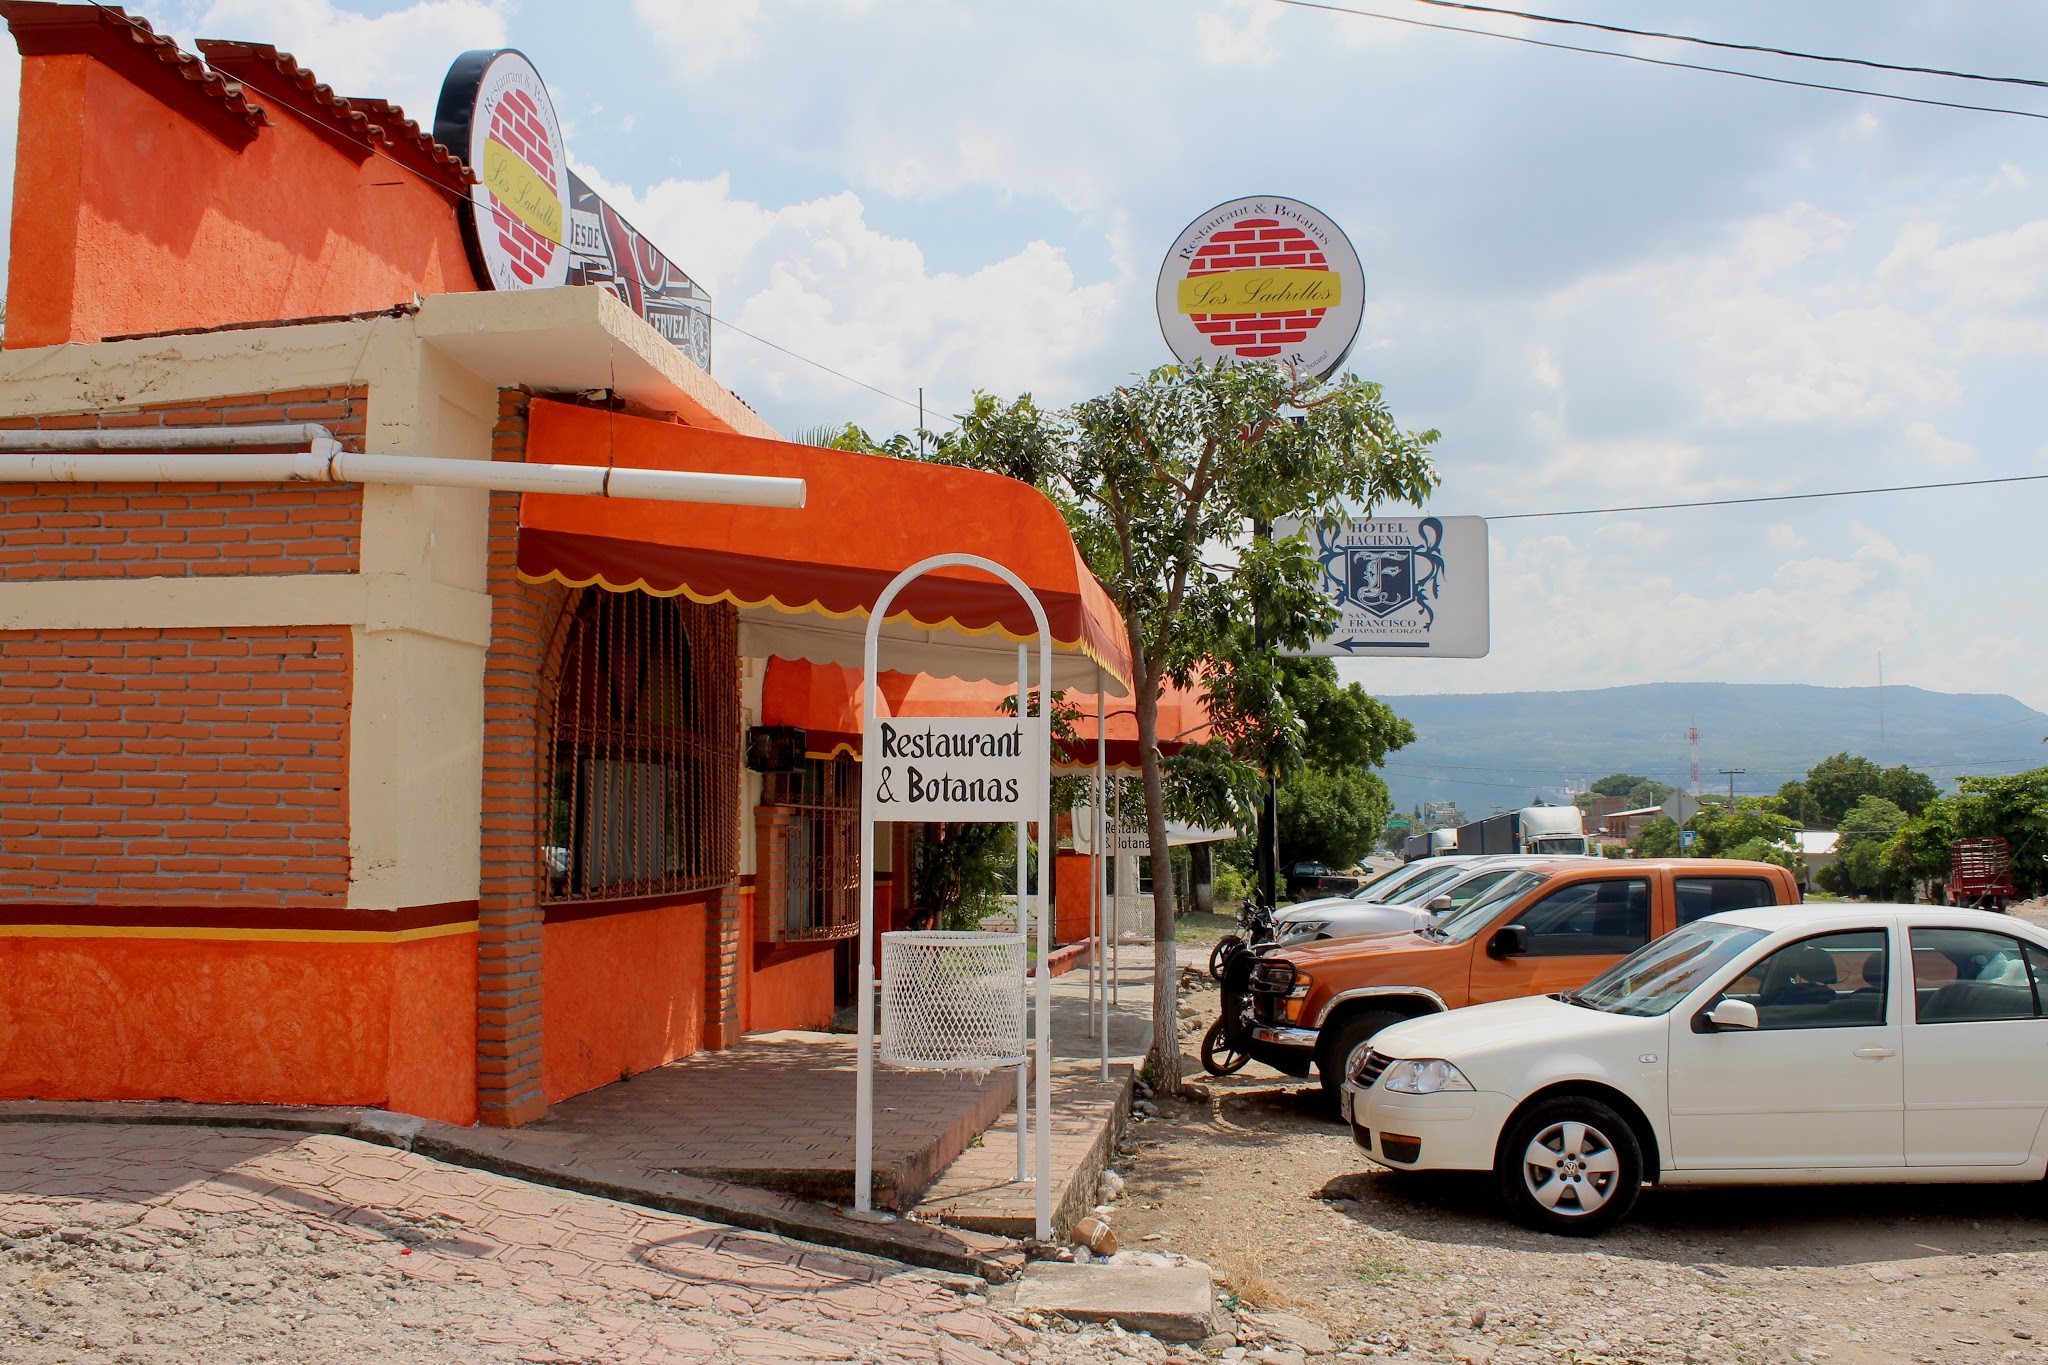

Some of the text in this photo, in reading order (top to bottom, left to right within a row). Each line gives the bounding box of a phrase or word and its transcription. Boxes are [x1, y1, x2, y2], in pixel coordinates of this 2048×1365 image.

[484, 72, 523, 115] Restaurant
[534, 84, 559, 159] Botanas
[487, 153, 557, 233] Los Ladrillos
[1179, 203, 1331, 260] Restaurant & Botanas
[1186, 278, 1333, 308] Los Ladrillos
[1346, 535, 1412, 546] HACIENDA
[1352, 523, 1408, 533] HOTEL
[1349, 619, 1416, 628] FRANCISCO
[880, 722, 1023, 758] Restaurant
[876, 766, 1019, 803] & Botanas
